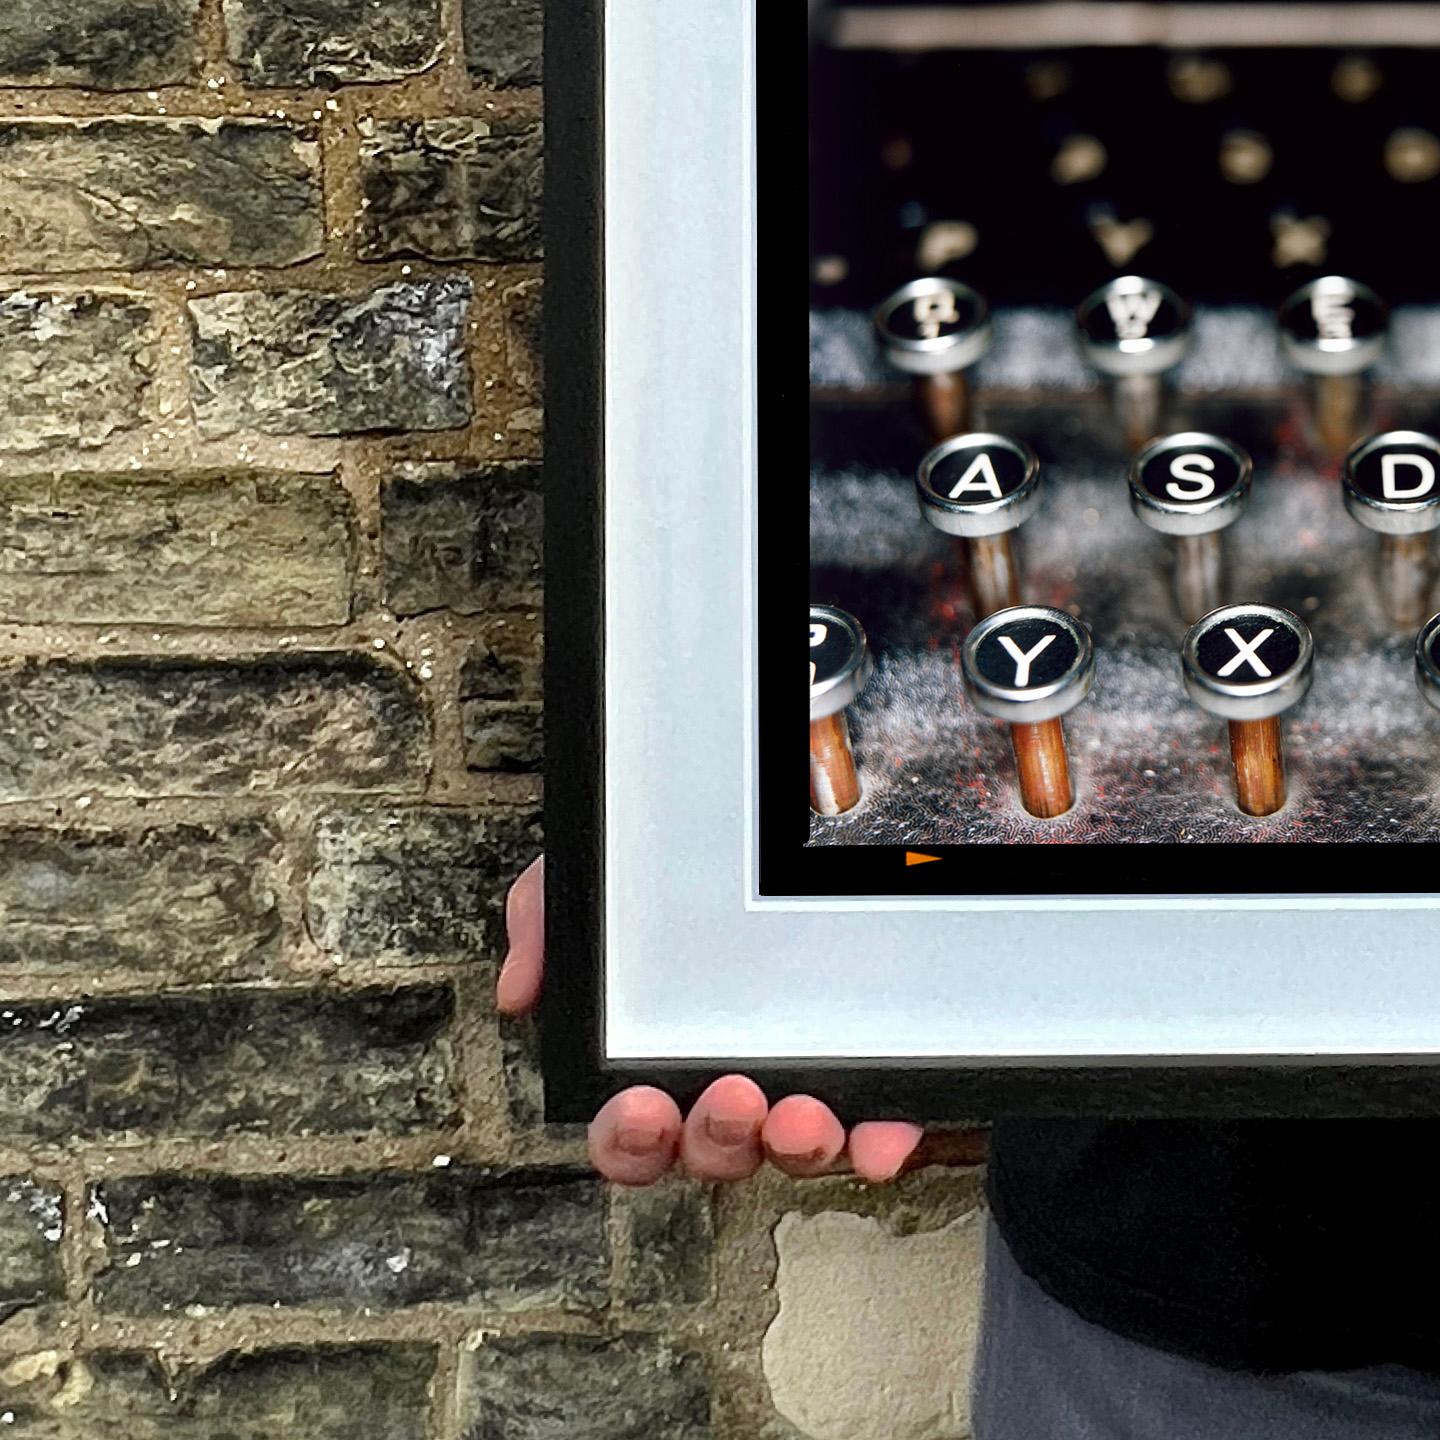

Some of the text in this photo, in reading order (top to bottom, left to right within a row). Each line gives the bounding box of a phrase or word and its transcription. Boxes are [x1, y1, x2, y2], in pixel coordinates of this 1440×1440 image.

[948, 453, 1003, 499] A
[1166, 453, 1216, 501] S
[1381, 454, 1436, 500] D
[997, 634, 1057, 687] Y
[1217, 628, 1274, 678] X
